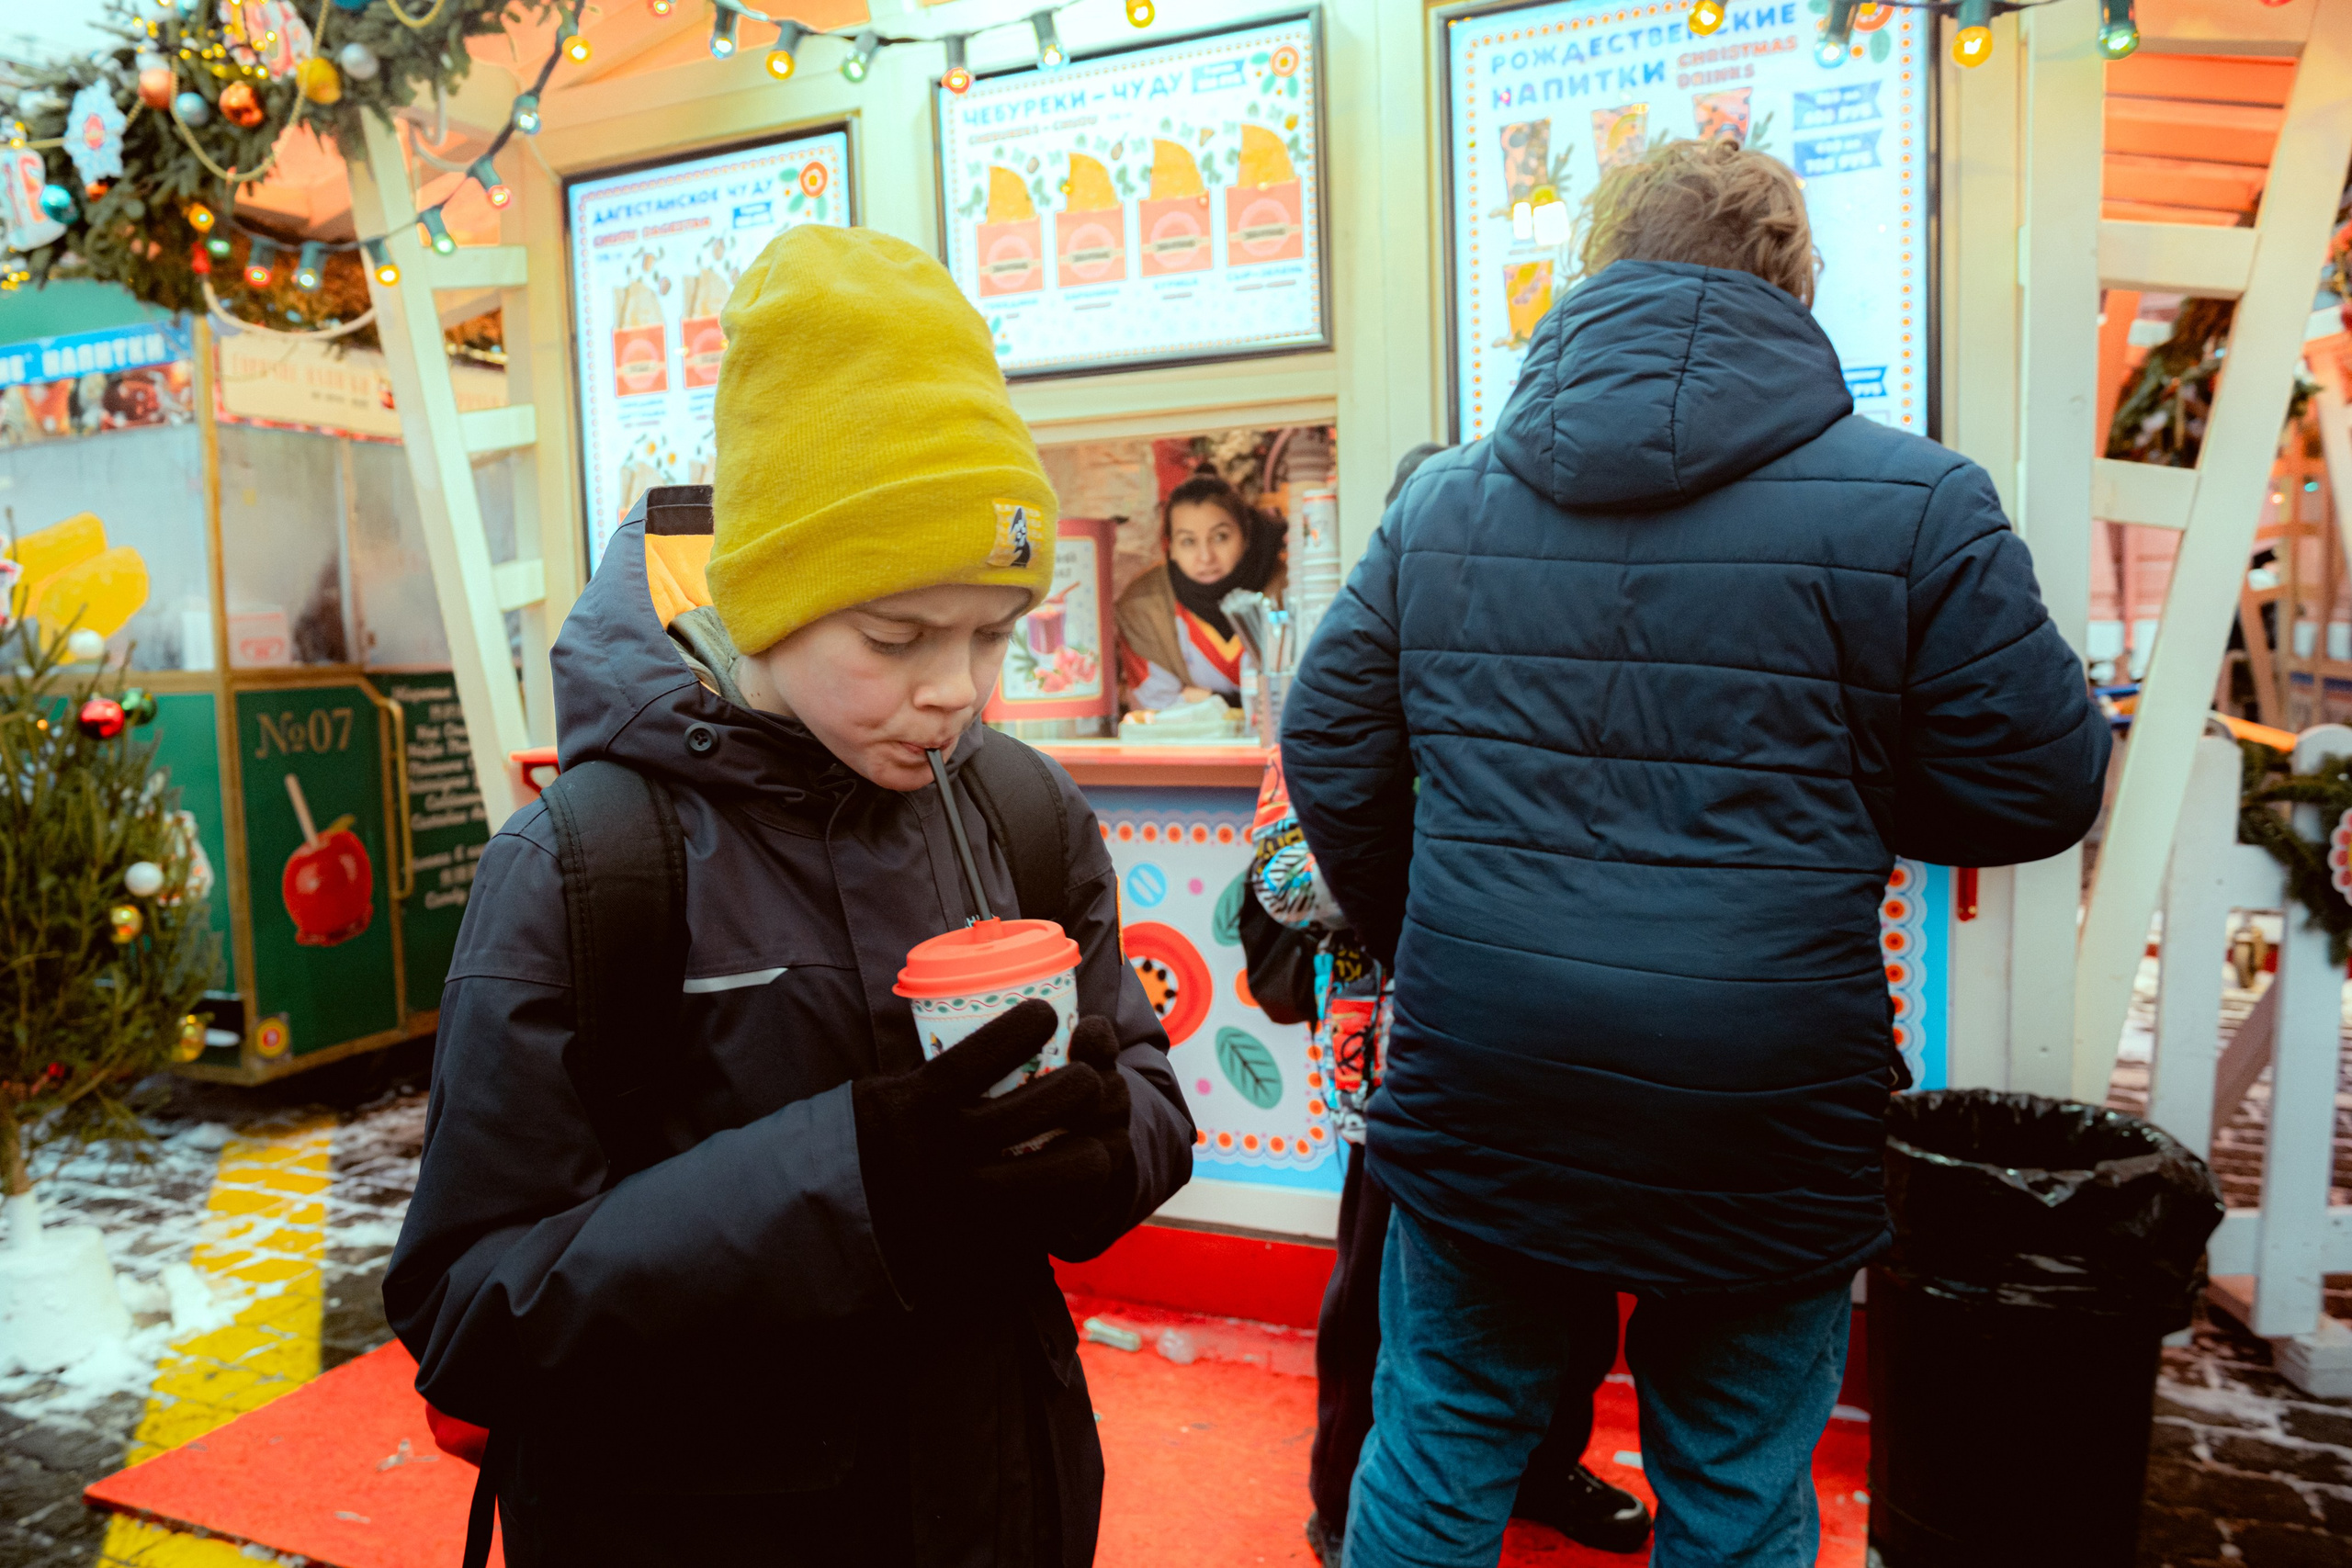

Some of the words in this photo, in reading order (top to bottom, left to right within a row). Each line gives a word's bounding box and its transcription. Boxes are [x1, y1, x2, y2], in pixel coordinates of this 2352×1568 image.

[1491, 3, 1797, 73] РОЖДЕСТВЕКИЕ
[1677, 35, 1797, 69] CHRISTMAS
[963, 90, 1086, 126] ЧЕБУРЕКИ
[1113, 72, 1183, 100] ЧУДУ
[1492, 60, 1666, 109] НАПИТКИ
[1677, 63, 1755, 90] DRINKS
[41, 333, 165, 377] НАПИТКИ
[255, 706, 354, 759] №07
